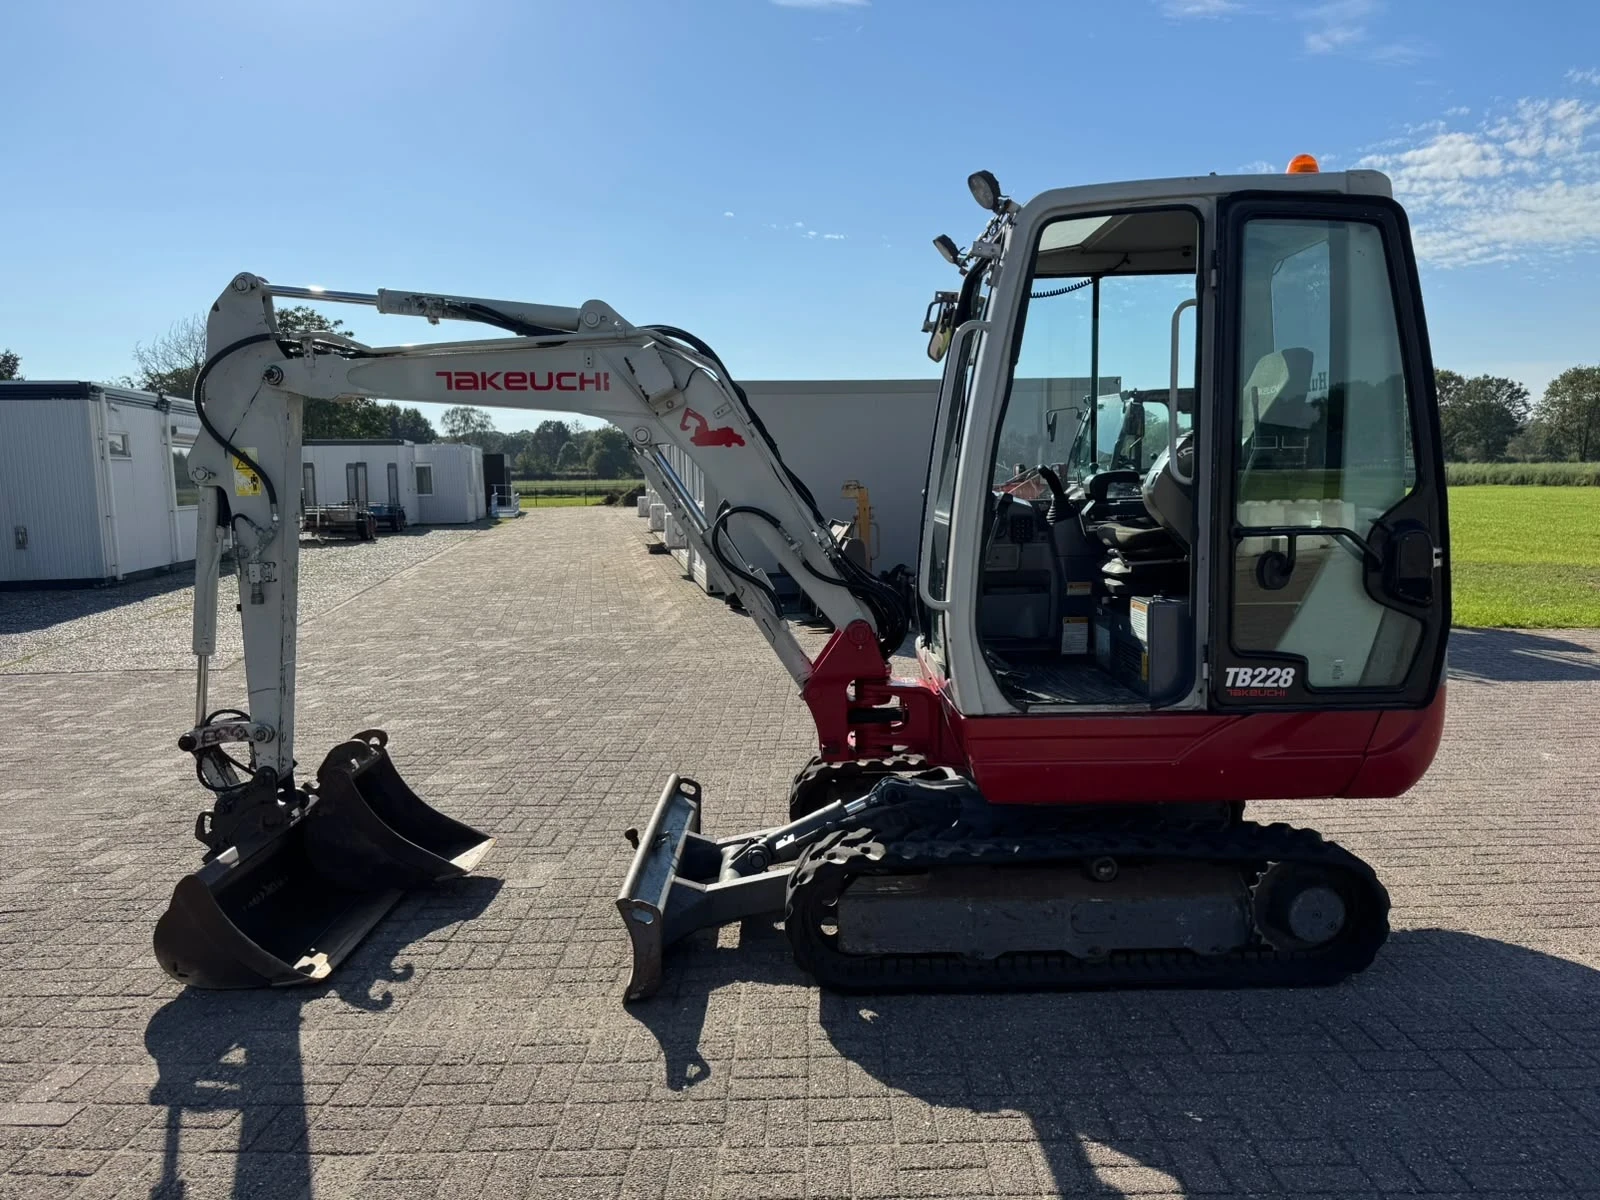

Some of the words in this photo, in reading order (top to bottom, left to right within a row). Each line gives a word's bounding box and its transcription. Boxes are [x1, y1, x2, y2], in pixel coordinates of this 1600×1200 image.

[436, 372, 610, 391] TAKEUCHI
[1225, 667, 1295, 688] TB228
[1226, 689, 1287, 697] TAKEUCHI
